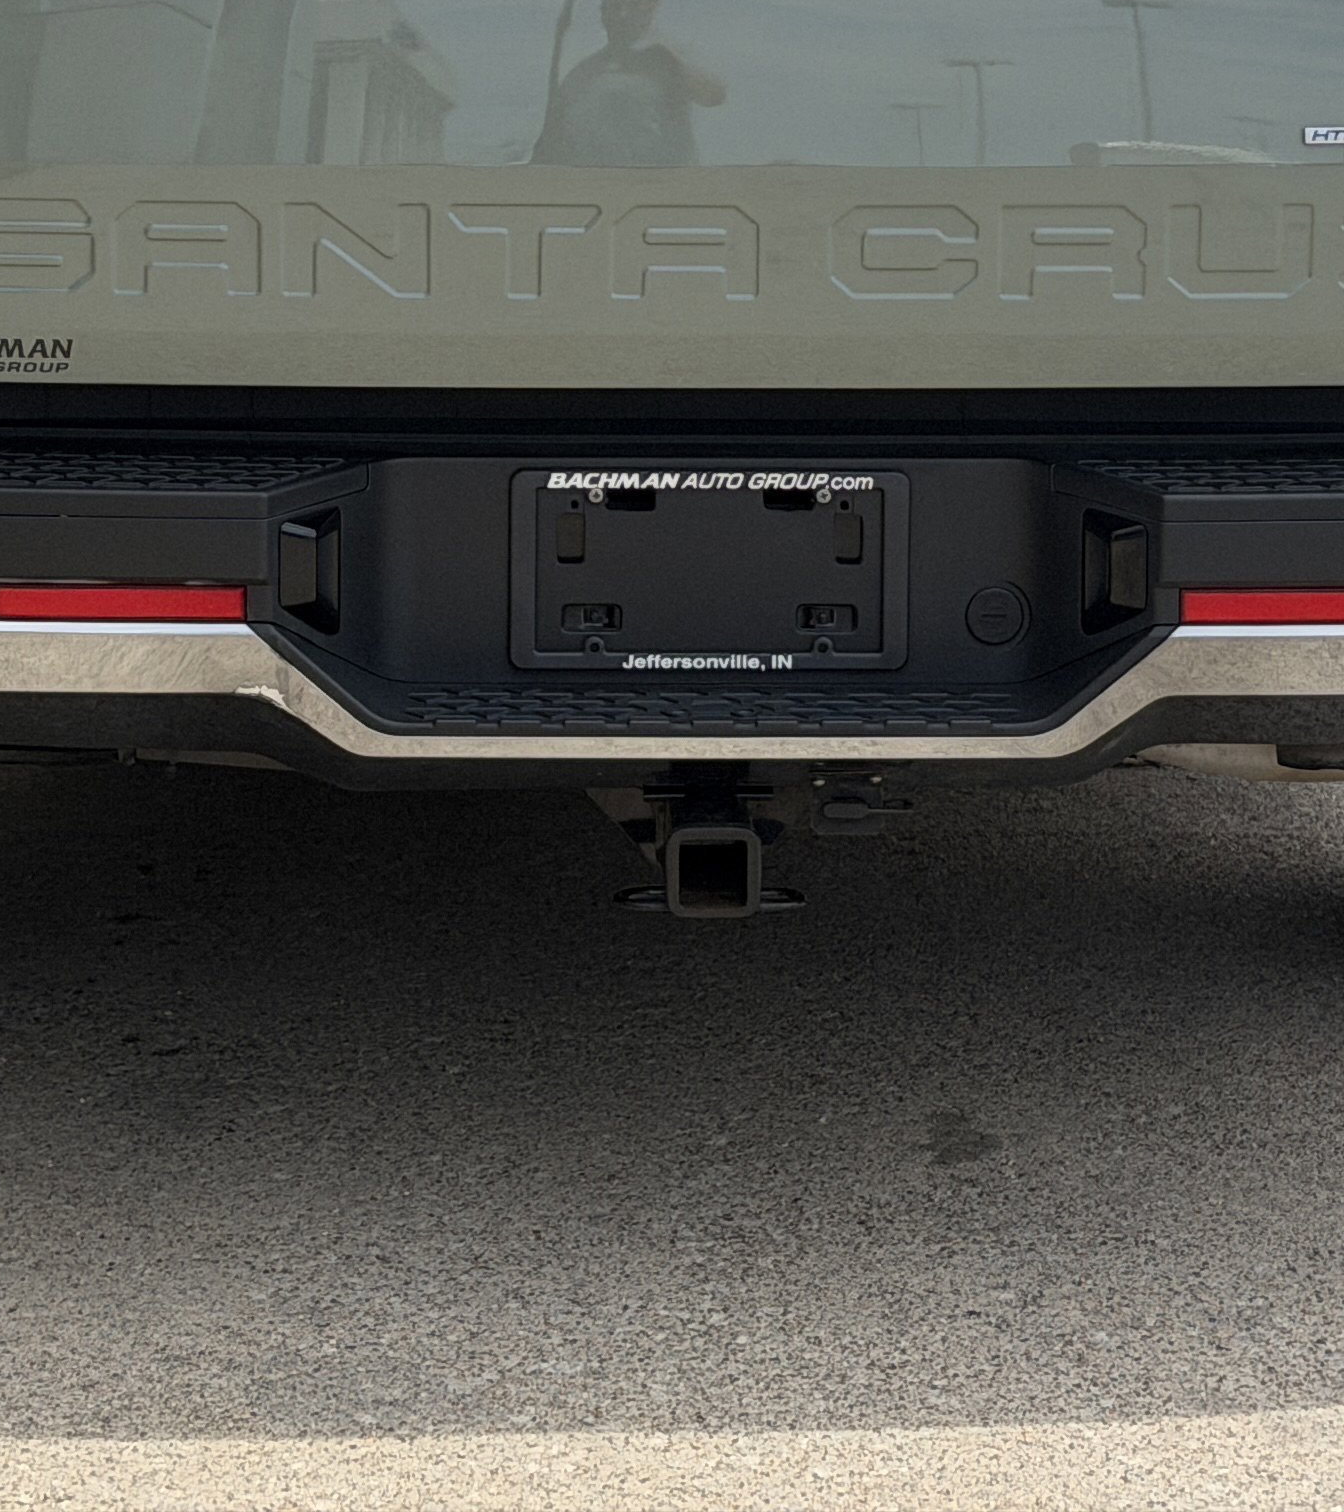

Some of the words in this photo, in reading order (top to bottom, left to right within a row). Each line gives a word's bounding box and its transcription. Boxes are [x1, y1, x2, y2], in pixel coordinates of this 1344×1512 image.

[547, 472, 680, 489] BACHMAN
[681, 472, 744, 489] AUTO
[747, 472, 874, 490] GROUP.com
[622, 654, 766, 672] Jeffersonville,
[771, 654, 793, 669] IN
